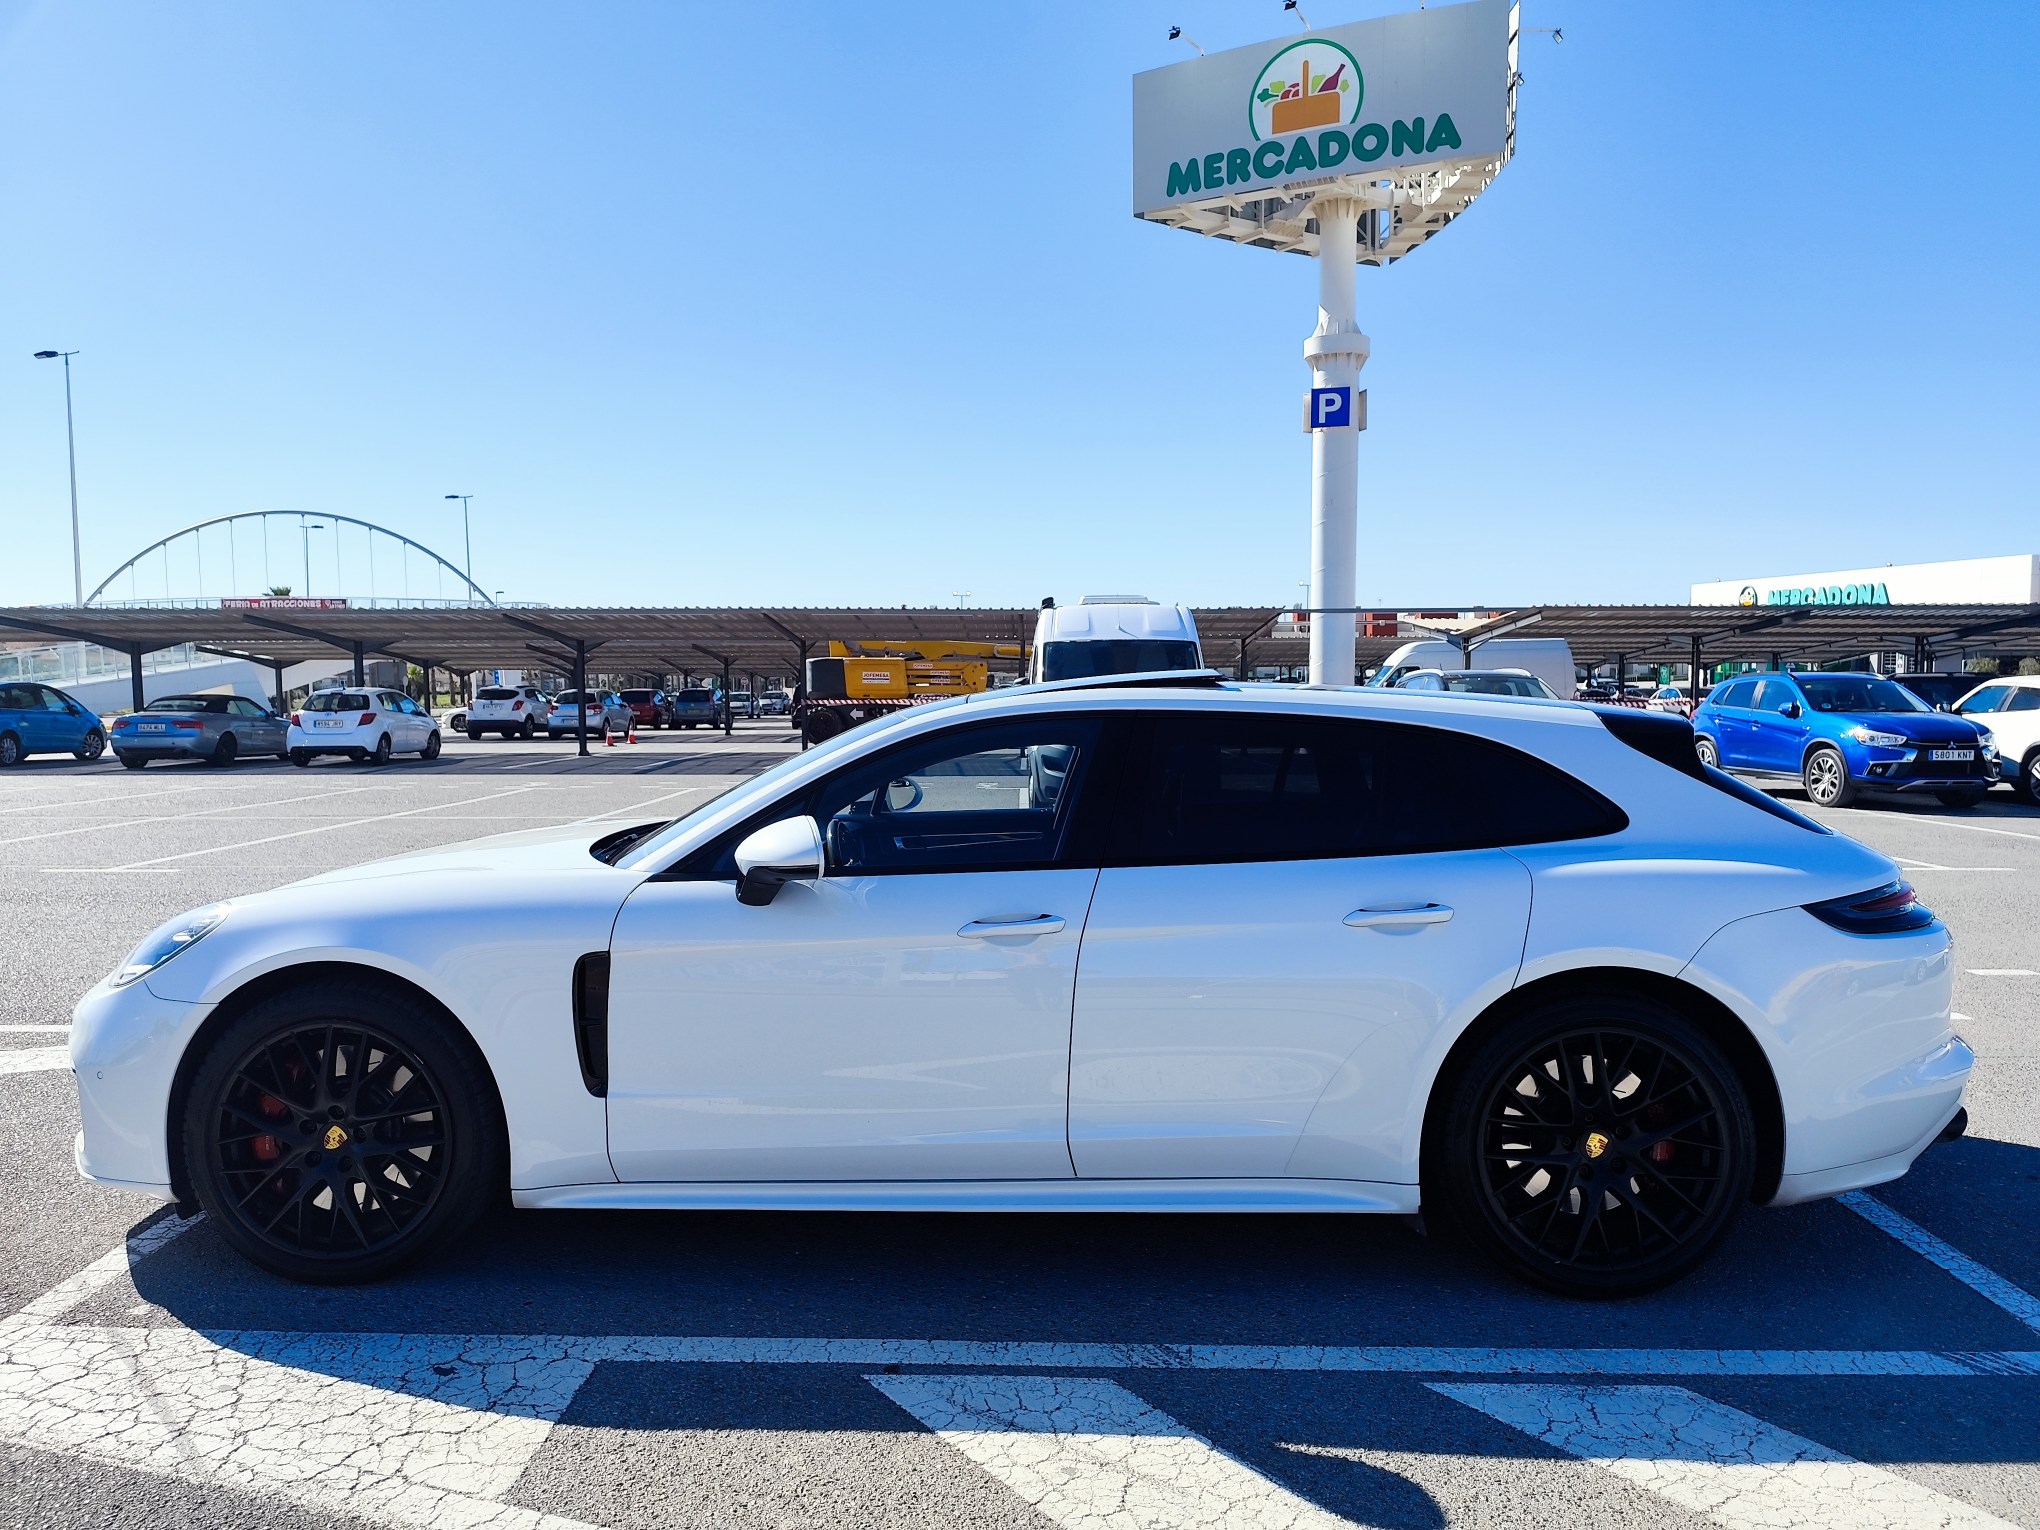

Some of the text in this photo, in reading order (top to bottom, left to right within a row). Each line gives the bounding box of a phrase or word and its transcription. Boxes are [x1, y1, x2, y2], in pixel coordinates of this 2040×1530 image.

[1166, 112, 1462, 198] MERCADONA
[1318, 392, 1343, 424] P
[225, 600, 250, 609] FERIA
[260, 599, 322, 609] ATRACCIONES
[1767, 582, 1890, 606] MERCADONA
[1934, 750, 1973, 760] 5801 KNT
